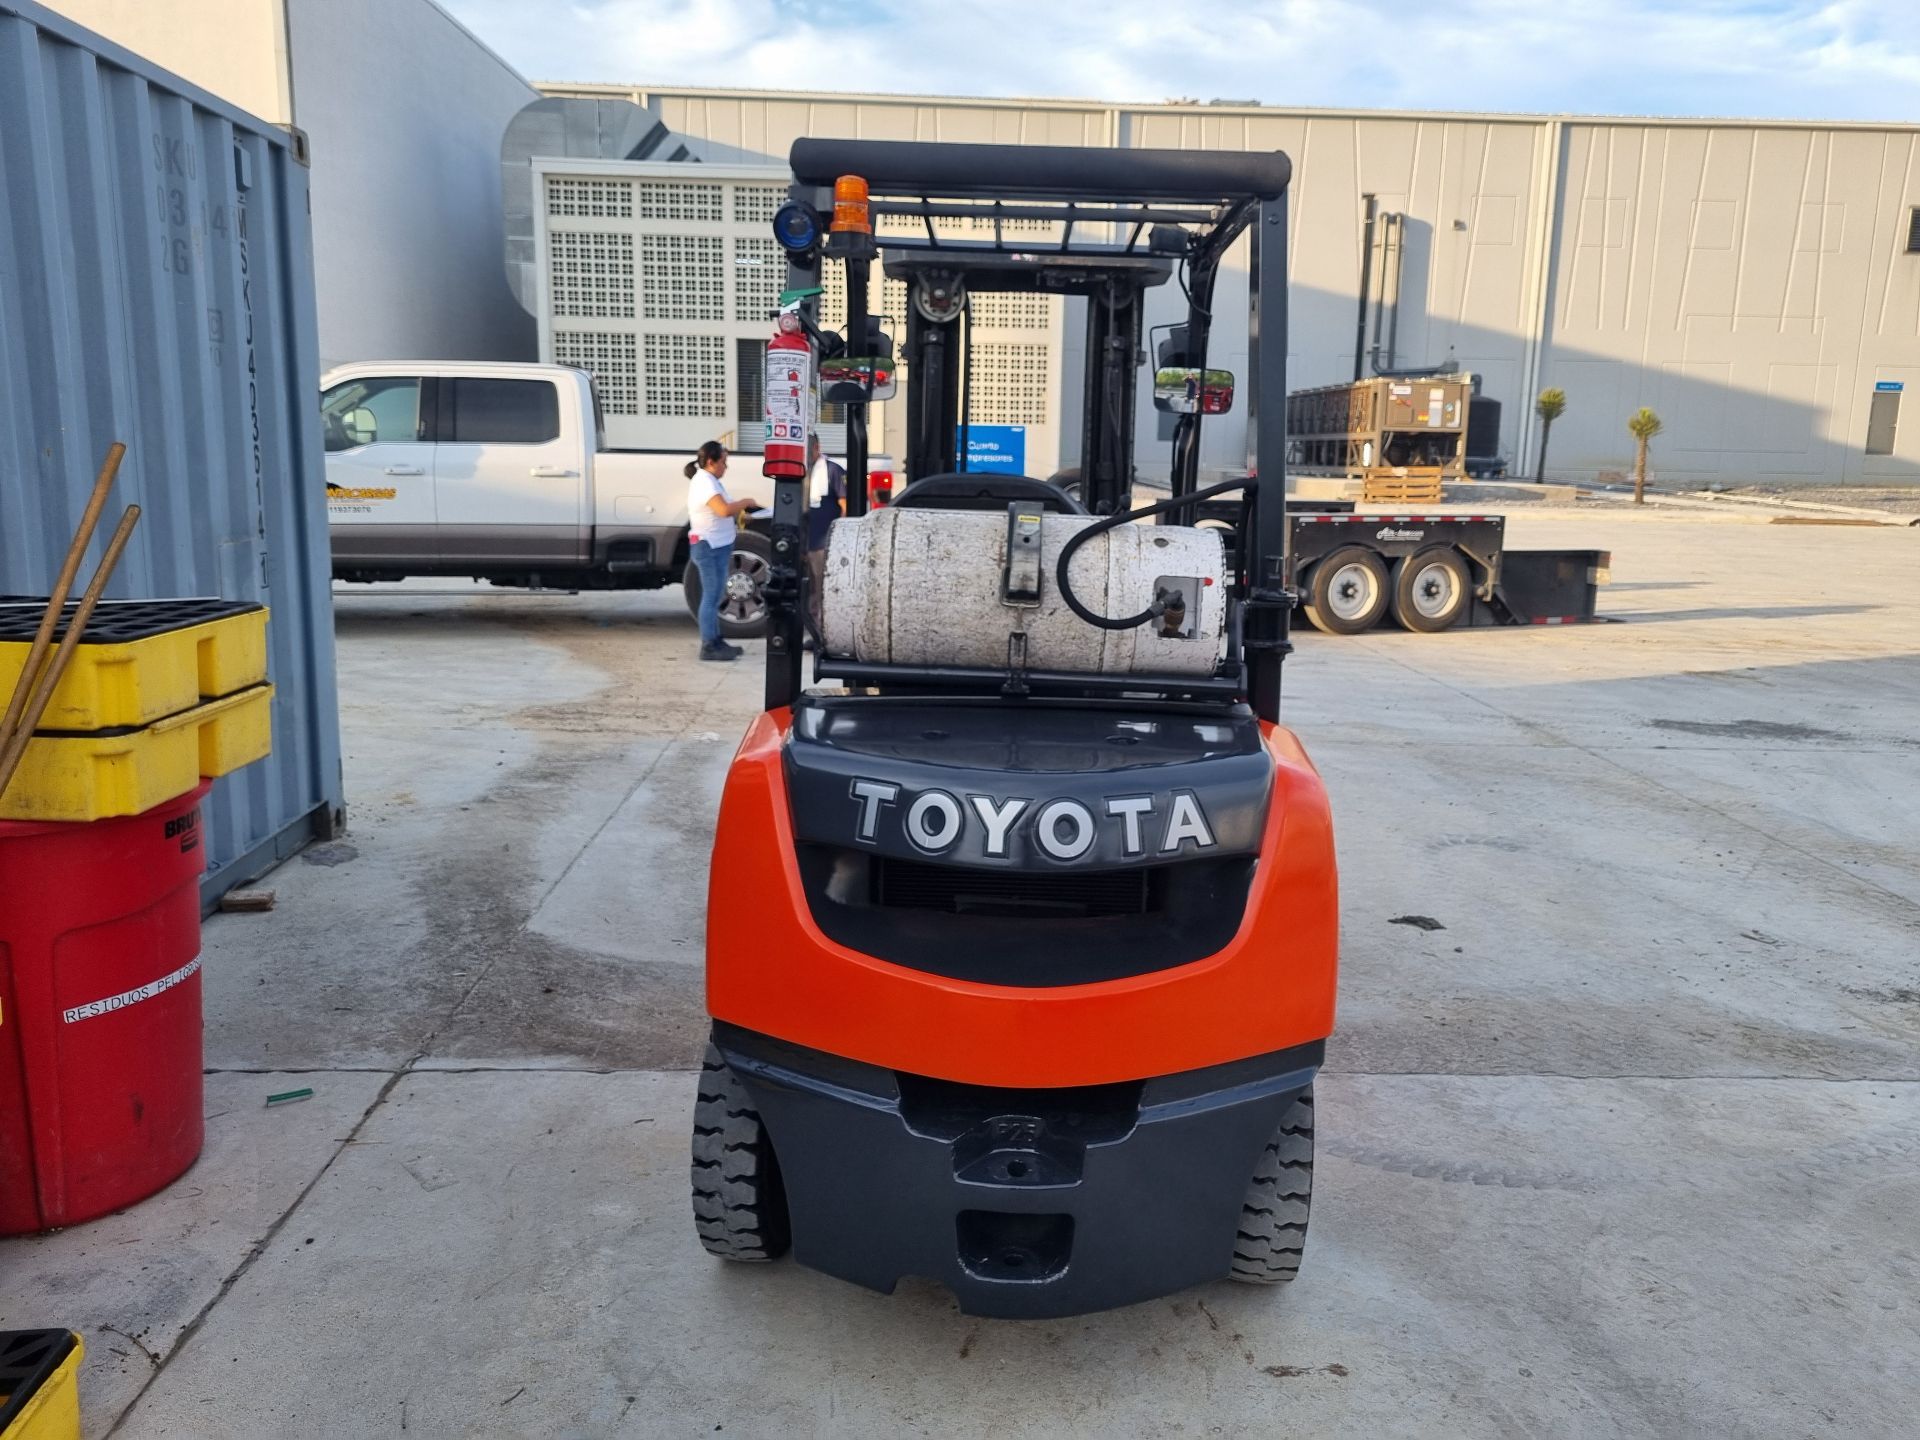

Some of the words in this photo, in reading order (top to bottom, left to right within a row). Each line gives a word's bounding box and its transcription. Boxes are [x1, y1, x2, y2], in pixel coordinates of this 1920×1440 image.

[165, 806, 202, 840] BRUT
[853, 781, 1217, 860] TOYOTA
[65, 987, 150, 1023] RESIDUOS
